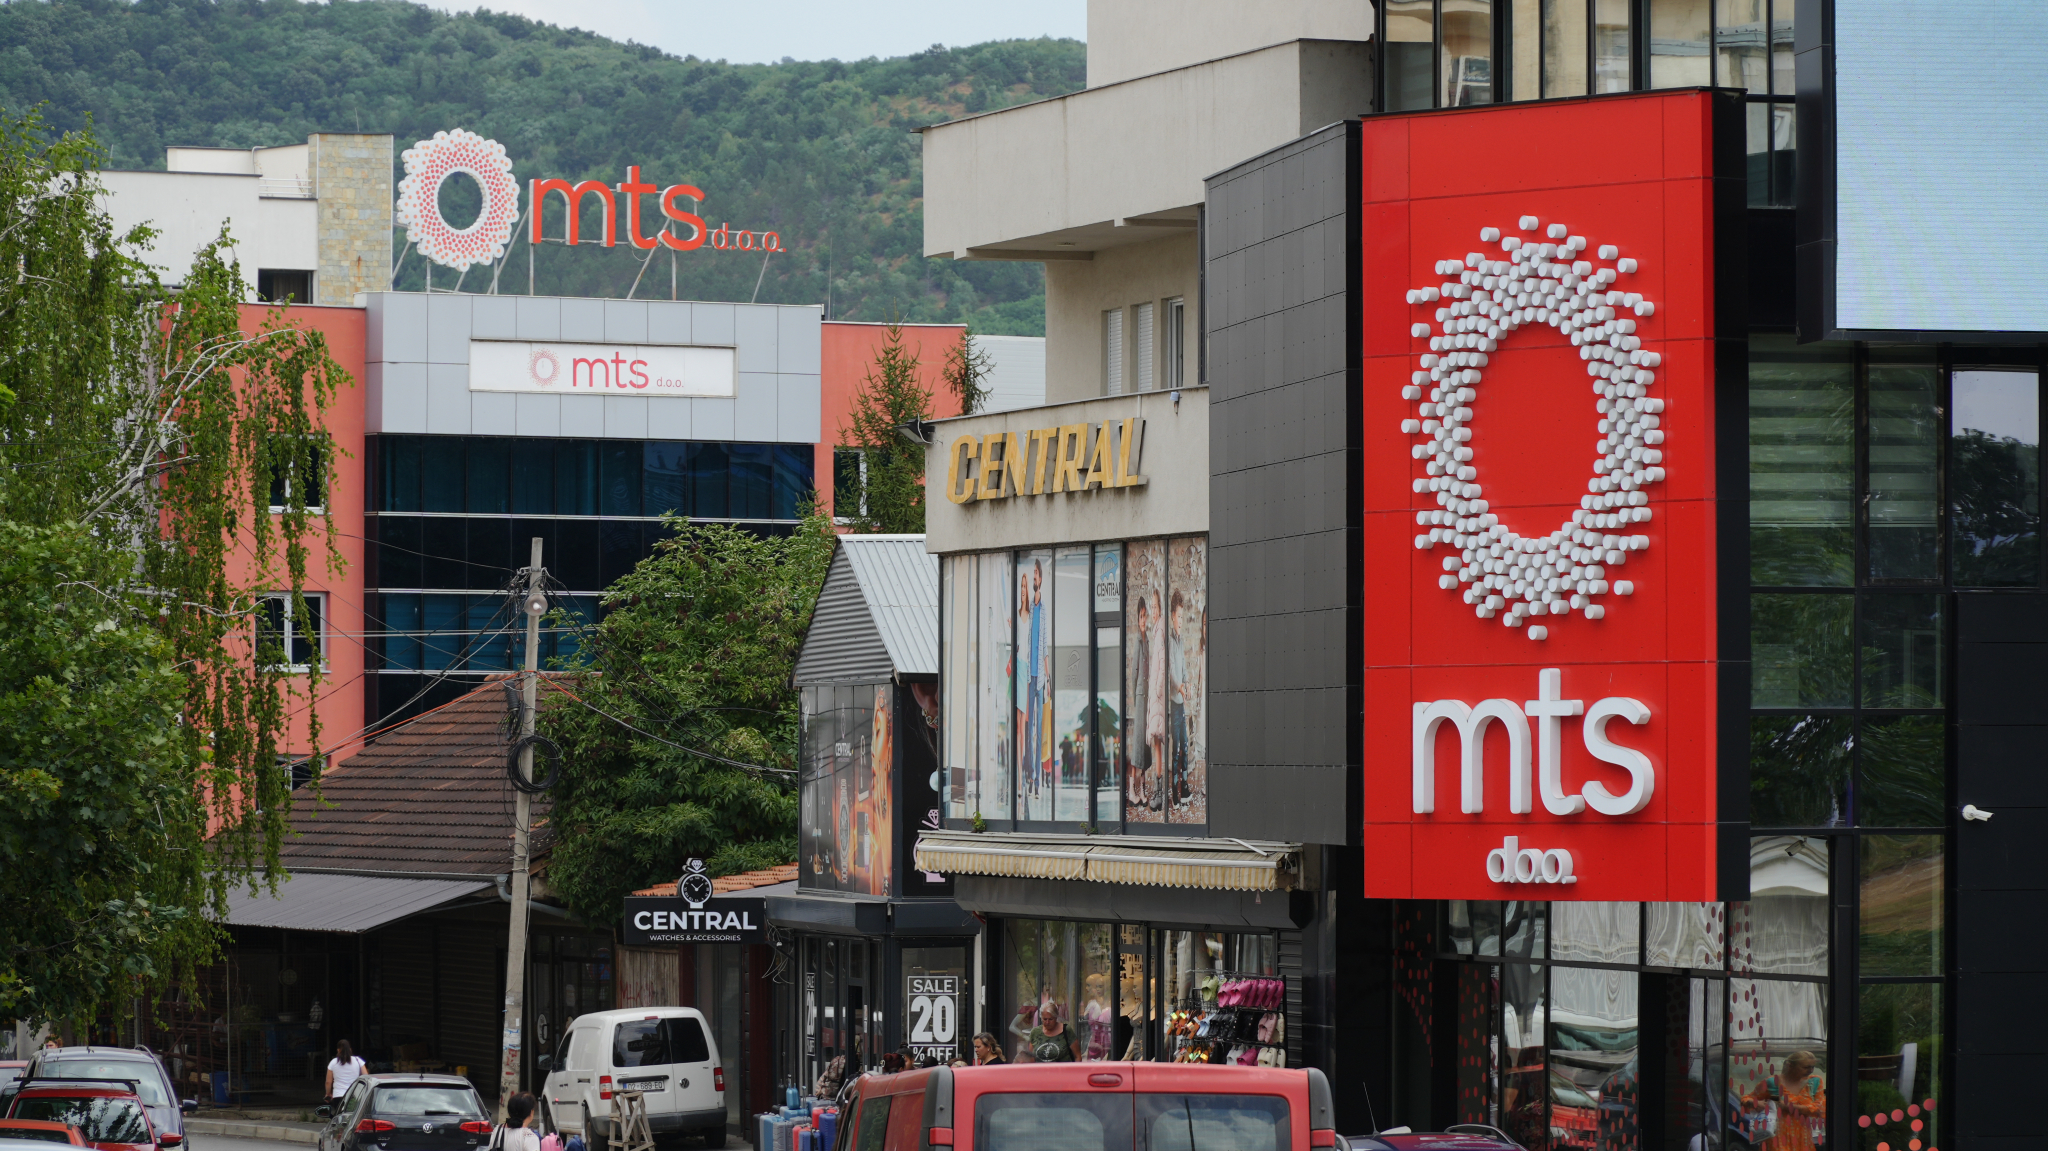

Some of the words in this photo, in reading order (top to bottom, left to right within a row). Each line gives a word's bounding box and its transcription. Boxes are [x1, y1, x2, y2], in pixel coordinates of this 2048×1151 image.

[529, 165, 707, 251] mts
[572, 351, 649, 389] mts
[656, 376, 685, 388] d.o.o.
[946, 417, 1148, 505] CENTRAL
[1413, 667, 1655, 816] mts
[634, 911, 757, 930] CENTRAL
[913, 979, 953, 993] SALE
[911, 995, 955, 1043] 20
